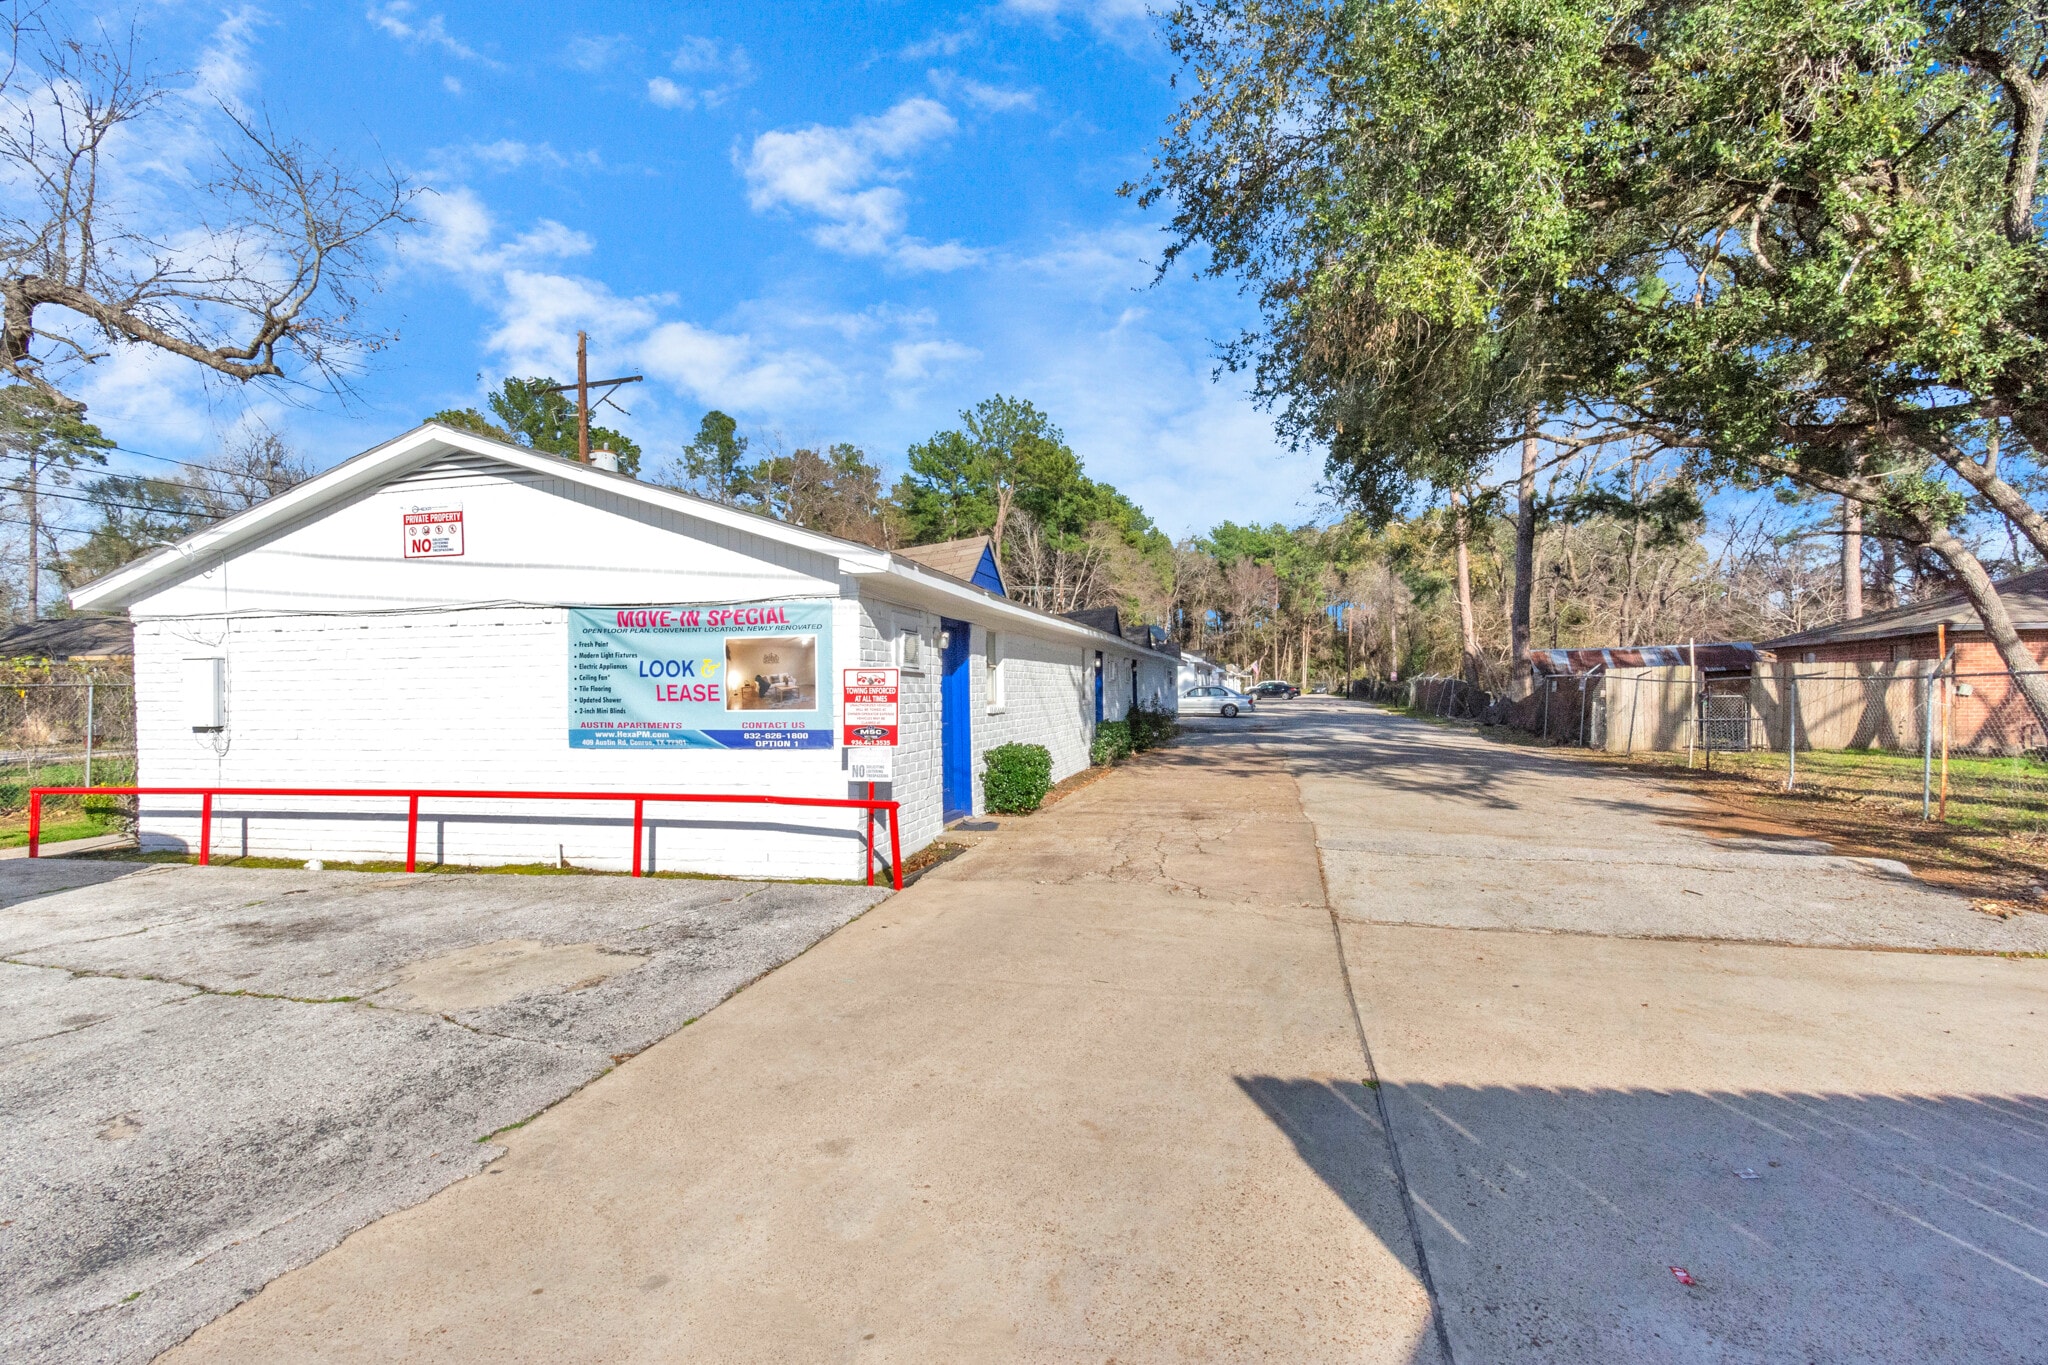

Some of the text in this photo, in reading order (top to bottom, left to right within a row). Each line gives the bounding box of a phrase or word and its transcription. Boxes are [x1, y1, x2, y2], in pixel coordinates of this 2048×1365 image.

[405, 512, 460, 524] PRIVATE PROPERTY
[412, 538, 431, 553] NO
[616, 606, 790, 628] MOVE-IN SPECIAL
[639, 658, 721, 678] LOOK &
[579, 674, 597, 682] Ceiling
[591, 685, 612, 693] Flooring
[656, 684, 720, 702] LEASE
[852, 764, 865, 778] NO
